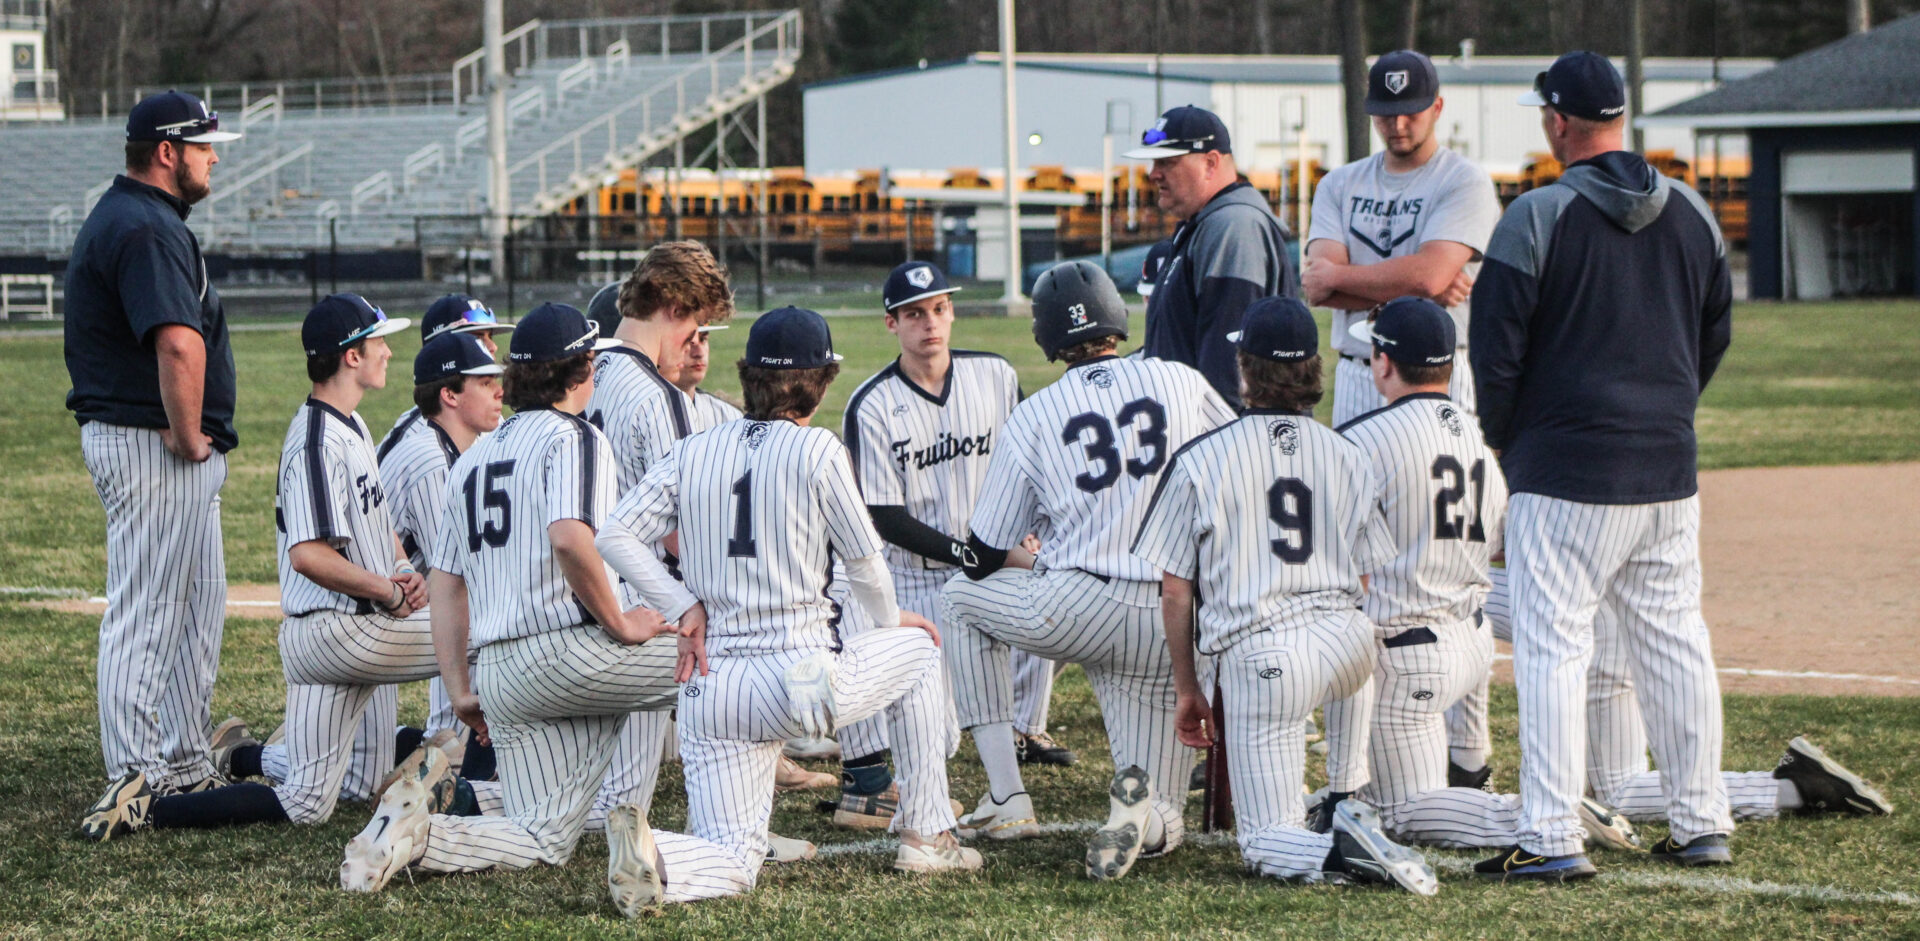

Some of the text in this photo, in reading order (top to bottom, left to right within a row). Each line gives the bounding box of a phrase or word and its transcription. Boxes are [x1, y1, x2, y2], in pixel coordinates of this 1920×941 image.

[1351, 196, 1423, 217] TROJANS
[1068, 303, 1086, 319] 33
[1273, 350, 1296, 358] FIGHT
[761, 356, 781, 365] FIGHT
[1061, 396, 1168, 494] 33
[462, 459, 517, 553] 15
[728, 468, 757, 558] 1
[1266, 476, 1314, 565] 9
[1430, 454, 1486, 543] 21
